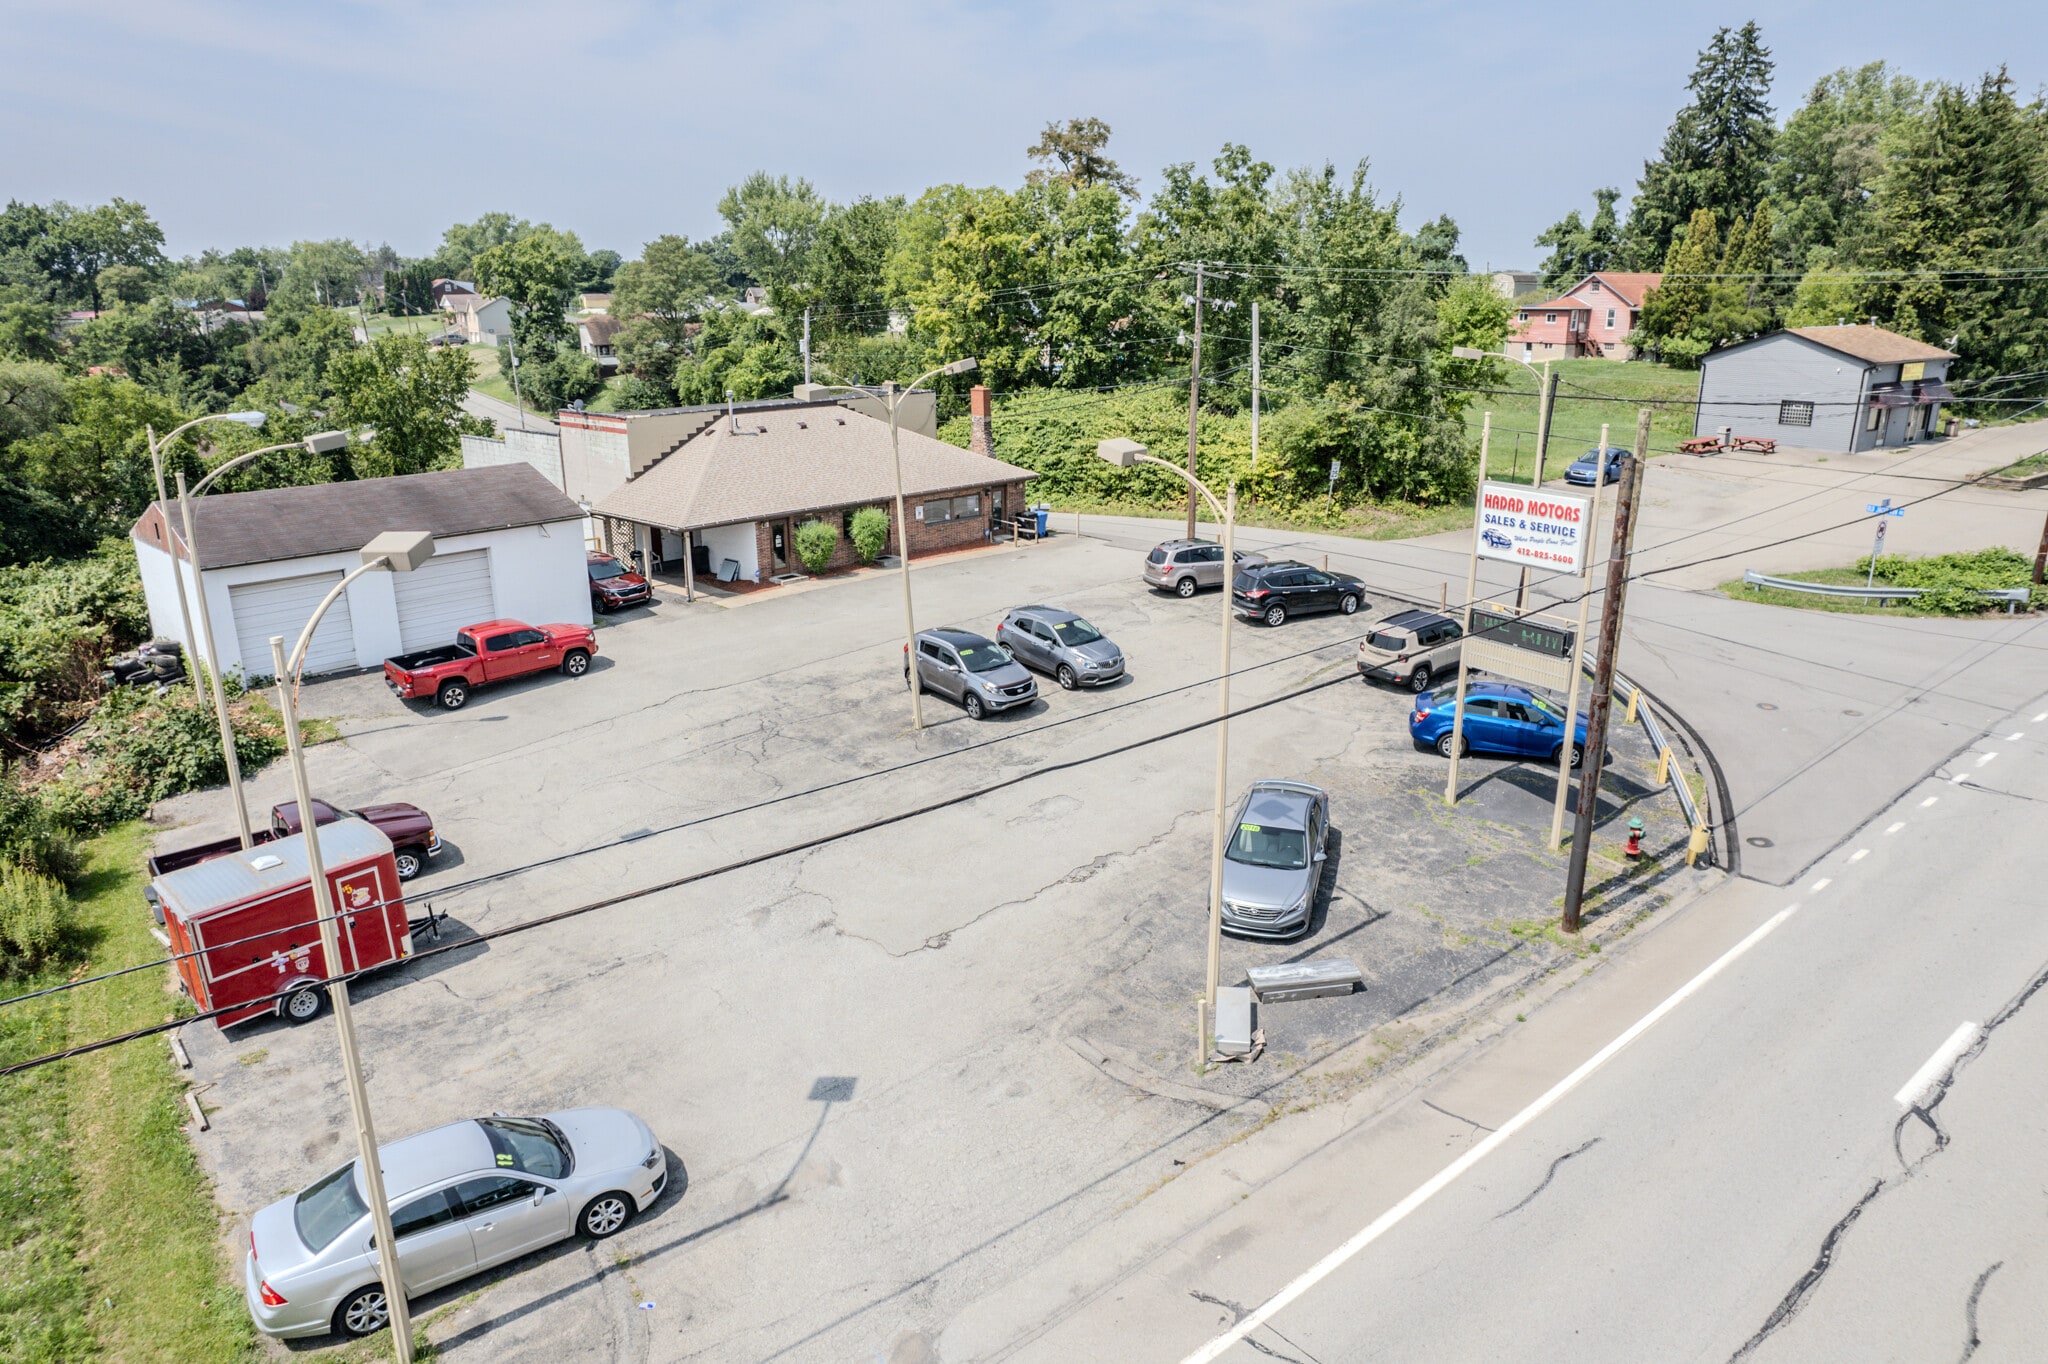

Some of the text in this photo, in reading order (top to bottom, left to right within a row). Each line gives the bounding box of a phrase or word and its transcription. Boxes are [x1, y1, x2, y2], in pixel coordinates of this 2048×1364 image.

[1485, 494, 1581, 522] HADAD MOTORS
[1484, 513, 1576, 538] SALES & SERVICE
[1517, 547, 1573, 564] 412-825-5600
